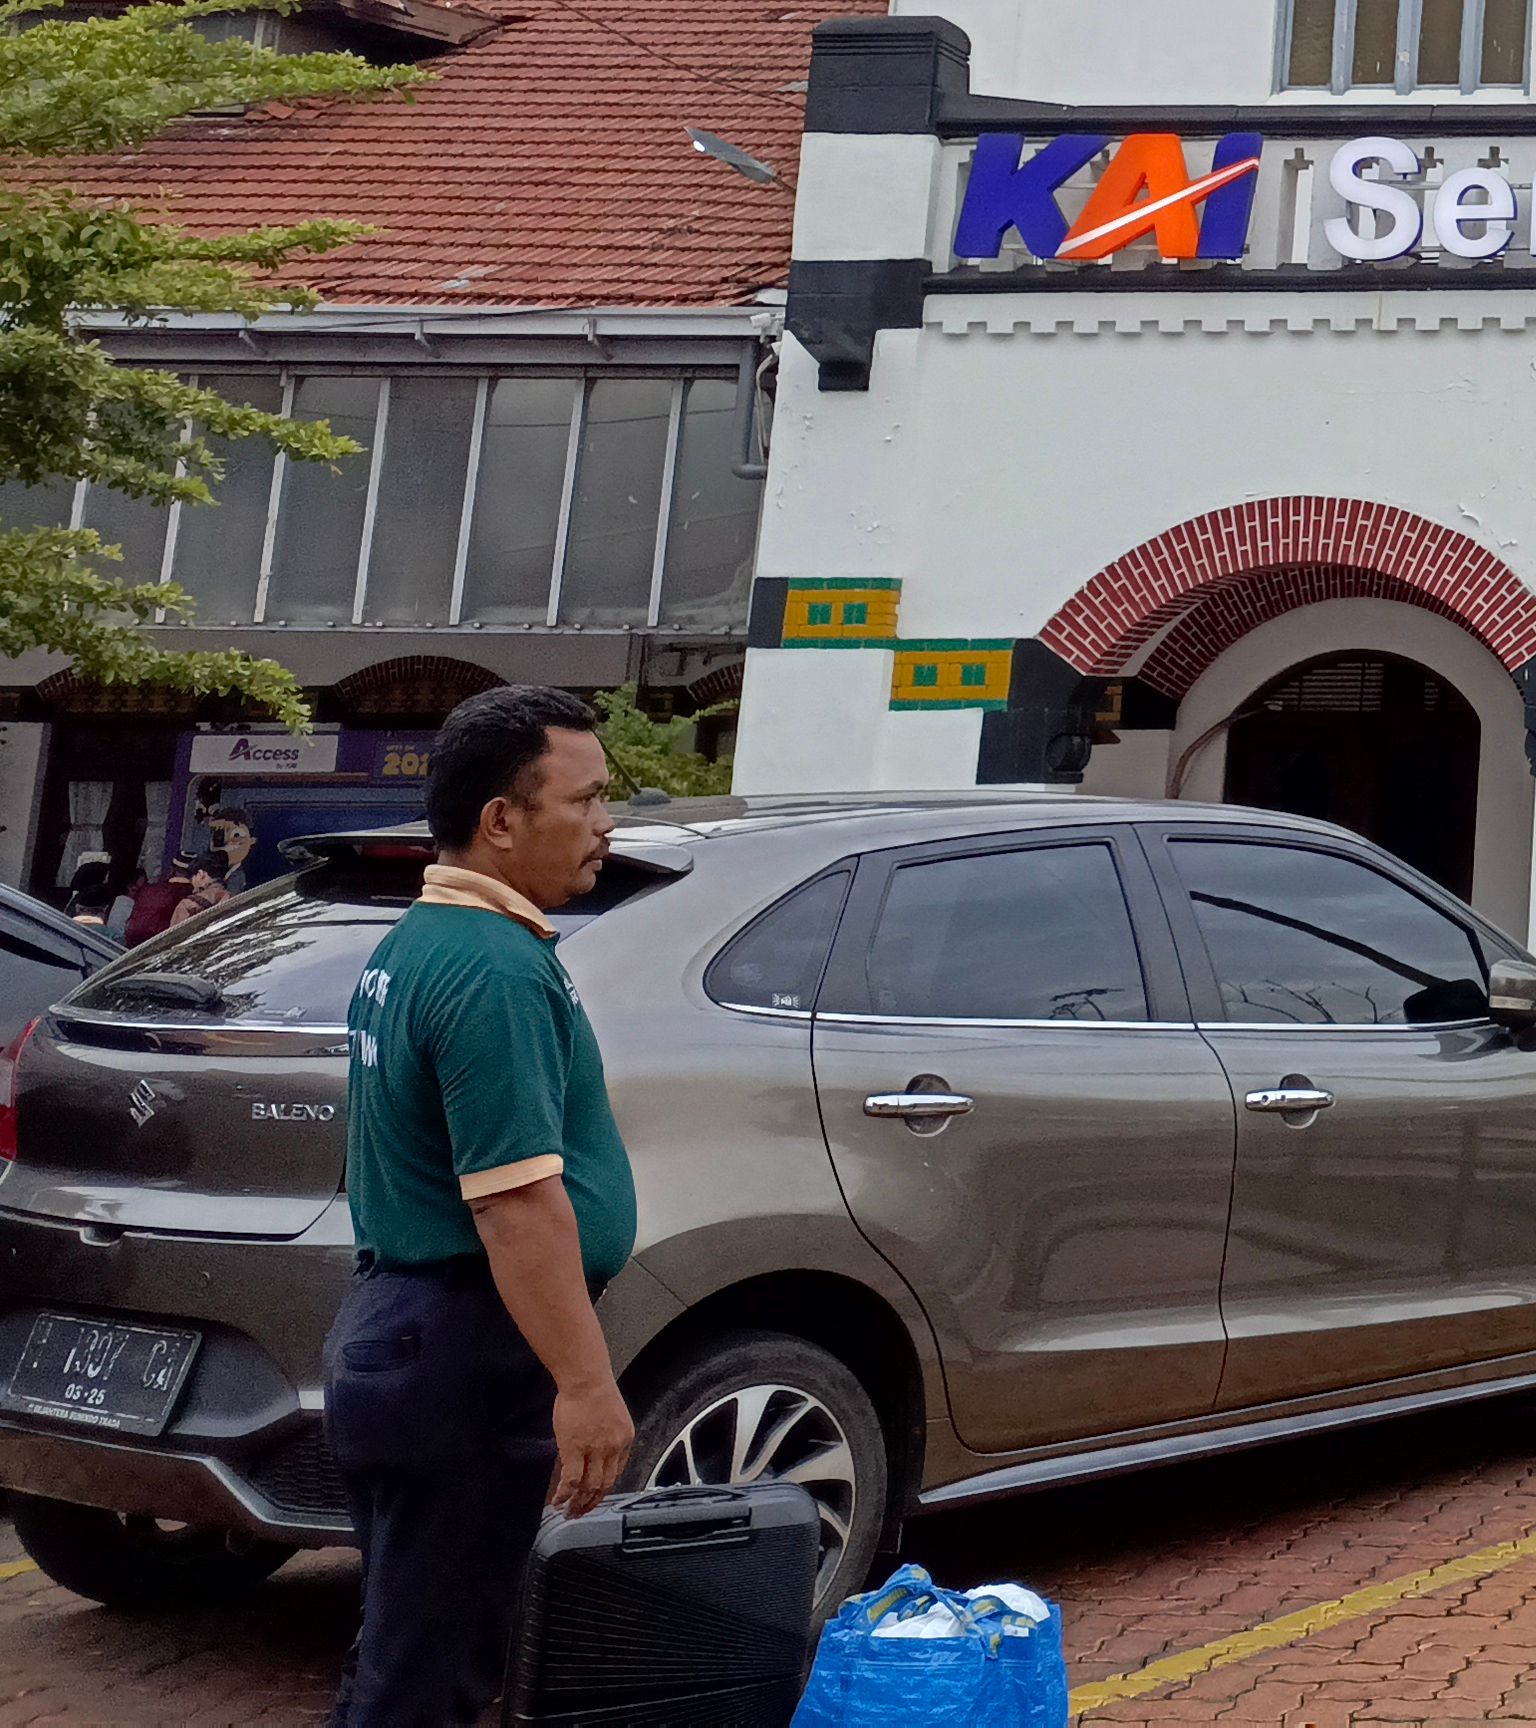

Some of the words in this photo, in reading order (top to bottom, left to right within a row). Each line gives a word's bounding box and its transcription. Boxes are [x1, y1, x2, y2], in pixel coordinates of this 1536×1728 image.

[952, 130, 1265, 260] KAI
[228, 738, 300, 761] Access
[251, 1103, 335, 1121] BALENO
